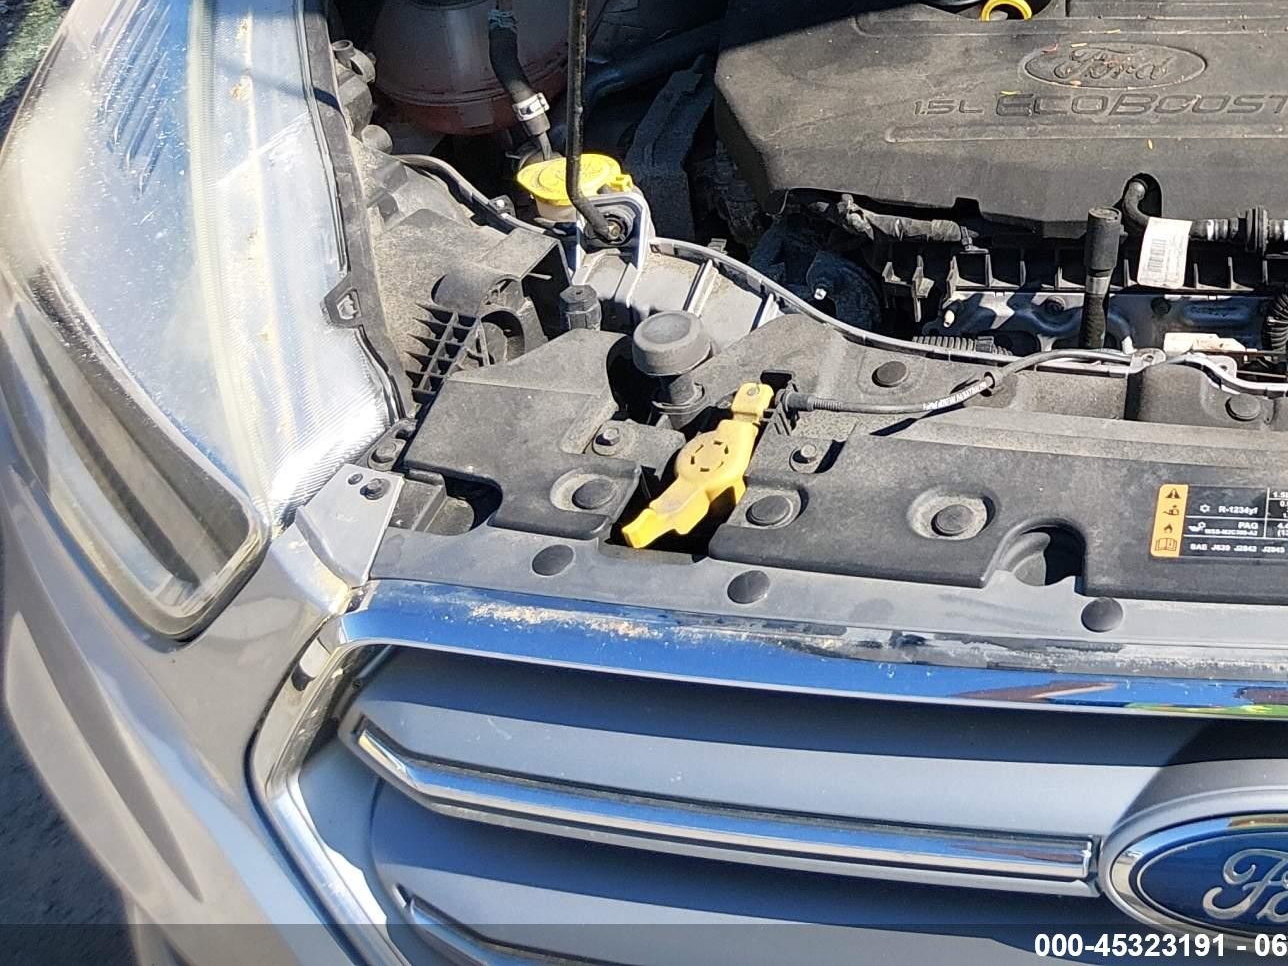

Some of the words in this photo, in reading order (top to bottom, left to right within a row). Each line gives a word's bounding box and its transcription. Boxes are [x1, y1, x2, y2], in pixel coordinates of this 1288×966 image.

[1053, 44, 1173, 82] Ford
[913, 98, 985, 116] 1.5L
[1238, 521, 1259, 530] PAG
[1189, 543, 1208, 551] SAE
